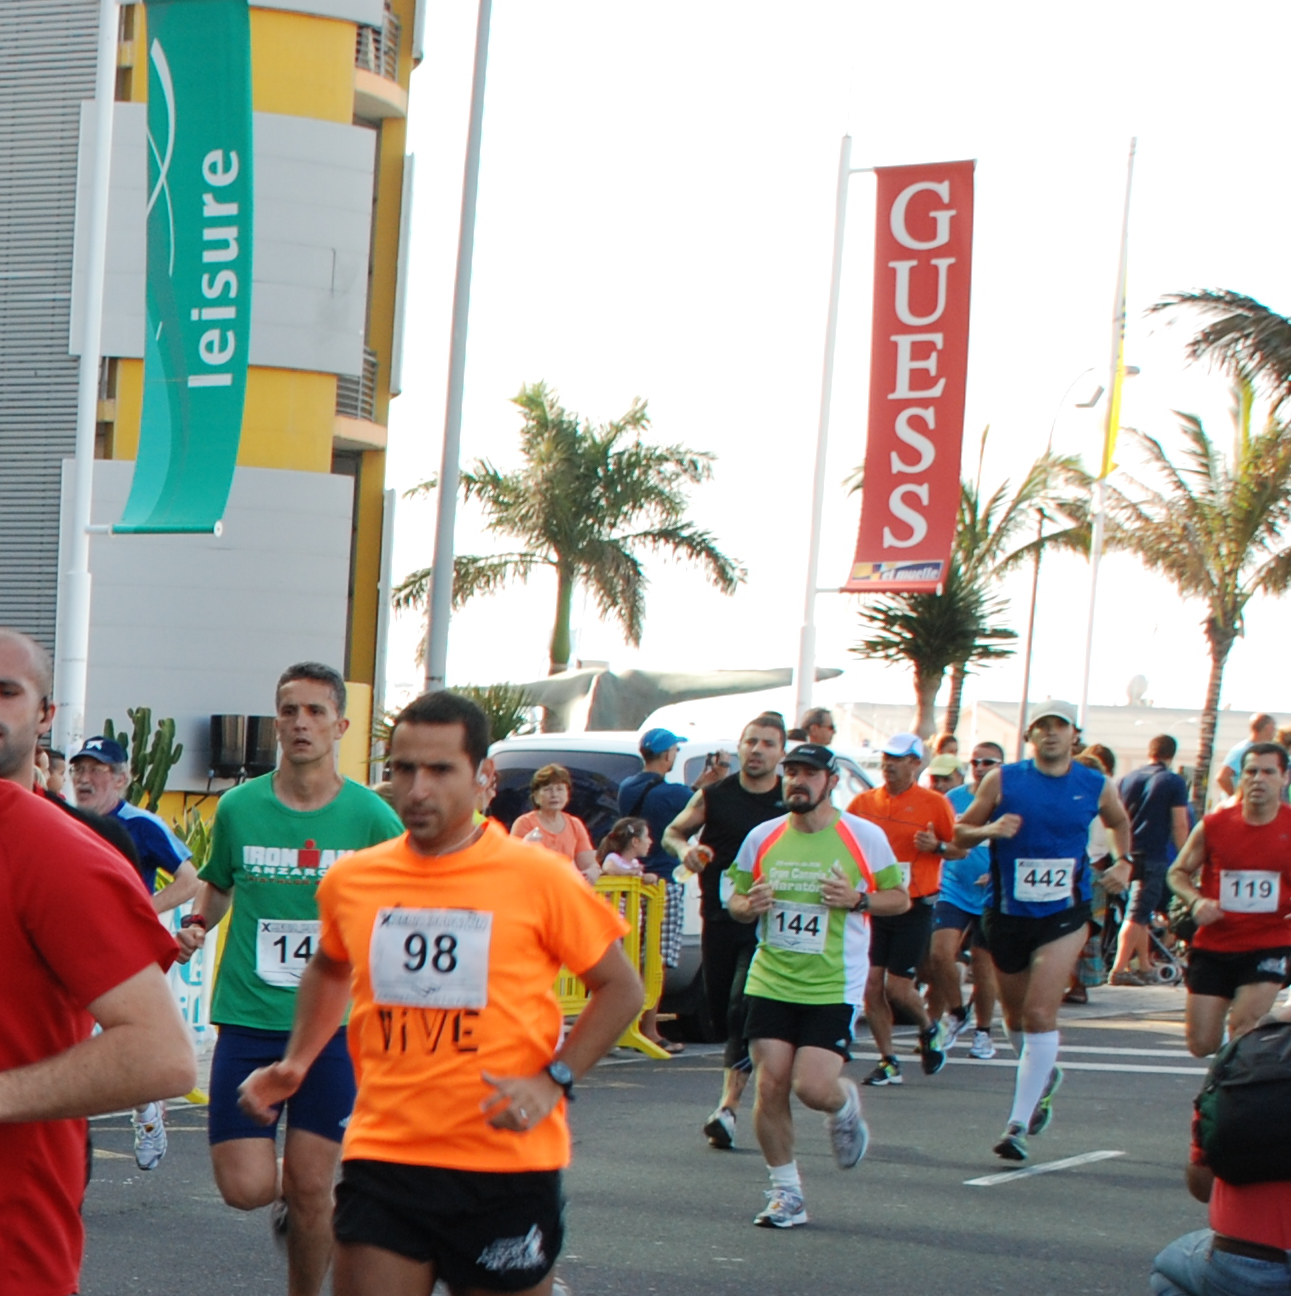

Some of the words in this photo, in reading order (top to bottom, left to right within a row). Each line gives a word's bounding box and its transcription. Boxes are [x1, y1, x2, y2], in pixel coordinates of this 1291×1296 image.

[188, 148, 239, 388] leisure
[882, 179, 957, 549] GUESS
[1023, 869, 1067, 887] 442
[1230, 880, 1273, 898] 119
[775, 911, 820, 937] 144
[403, 932, 458, 973] 98
